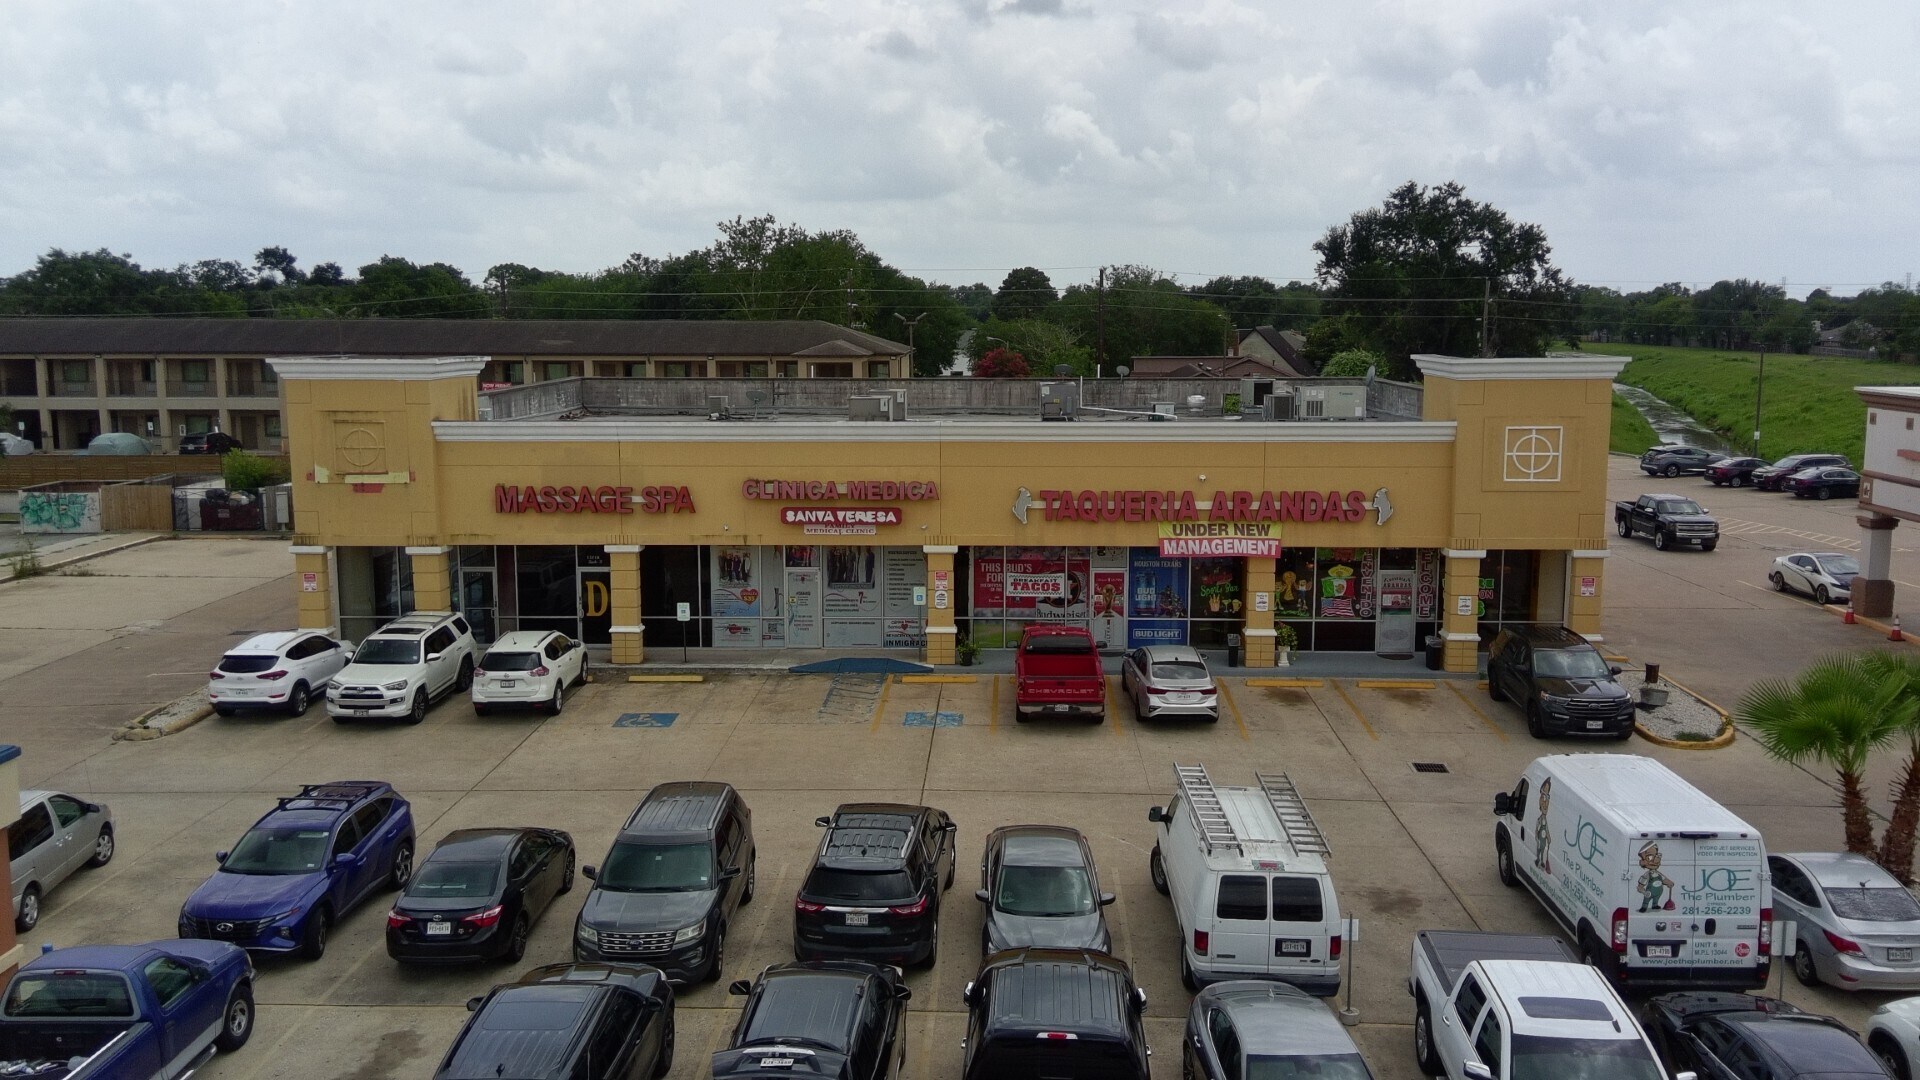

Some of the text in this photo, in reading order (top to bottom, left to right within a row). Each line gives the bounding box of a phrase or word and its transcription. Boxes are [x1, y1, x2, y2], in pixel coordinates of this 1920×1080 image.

[495, 484, 696, 514] MASSAGE SPA
[742, 480, 940, 501] CLINICA MEDICA
[1040, 490, 1367, 522] TAQUERIA ARANDAS
[785, 510, 835, 522] SANTA
[1172, 523, 1271, 537] UNDER NEW
[1163, 538, 1279, 556] MANAGEMENT
[980, 562, 1033, 573] THIS BUD'S
[986, 573, 1003, 582] FOR
[1010, 582, 1060, 591] TACOS
[585, 581, 608, 616] D
[1564, 814, 1608, 876] JOE
[1562, 850, 1575, 870] The
[1681, 868, 1755, 892] JOE
[1680, 892, 1756, 901] The Plumber
[1682, 907, 1751, 915] 281-256-2239
